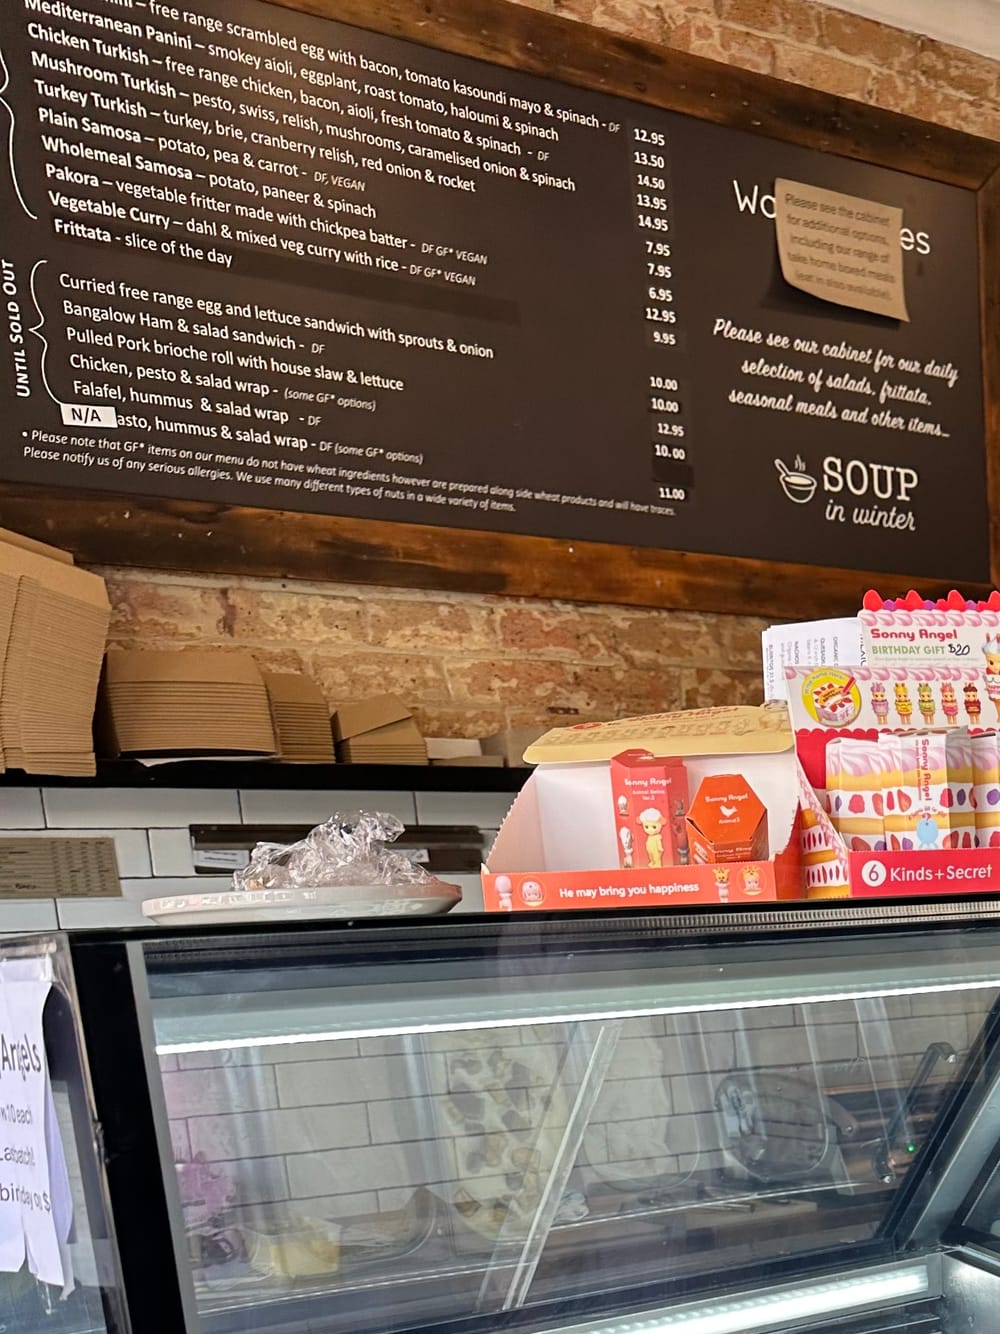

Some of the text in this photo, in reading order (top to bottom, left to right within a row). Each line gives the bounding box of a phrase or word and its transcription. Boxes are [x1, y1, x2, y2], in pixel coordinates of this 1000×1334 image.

[24, 0, 559, 141] Mediterranean Panini smokey aioli, eggplant, roast tomato, haloumi & spinach
[31, 50, 575, 191] Mushroom Turkish pesto, swiss, relish, mushrooms, caramelised onion & spinach
[633, 128, 665, 146] 12.95
[633, 151, 664, 168] 13.50
[41, 134, 376, 218] Wholemeal Samosa potato, paneer & spinach
[637, 173, 665, 190] 14.50
[636, 193, 667, 210] 13.95
[637, 214, 668, 231] 14.95
[54, 218, 232, 268] Frittata slice of the day
[645, 240, 670, 256] 7.95
[647, 262, 671, 278] 7.95
[648, 286, 672, 302] 6.95
[59, 273, 493, 358] Curried free range egg and lettuce sandwich with sprouts & onion
[645, 307, 676, 323] 12.95
[1, 259, 31, 398] UNTIL SOLD OUT
[653, 330, 676, 345] 9.95
[713, 318, 959, 388] Please see our cabinet for our daily
[649, 376, 677, 390] 10.00
[742, 358, 804, 383] selection
[808, 370, 823, 393] of
[651, 397, 678, 412] 10.00
[729, 389, 793, 412] seasonal
[796, 401, 837, 420] meals
[841, 406, 868, 425] and
[871, 411, 905, 430] other
[71, 408, 102, 423] N/A
[657, 422, 684, 437] 12.95
[23, 446, 233, 480] Please notify us of any serious allergies.
[823, 457, 919, 501] SOUP
[658, 487, 685, 500] 11.00
[825, 500, 916, 531] in winter
[870, 629, 958, 642] Sonny Angel
[872, 645, 946, 655] BIRTHDAY GIFT
[948, 644, 971, 656] $20
[921, 739, 932, 801] Sonny Angel
[868, 864, 879, 882] 6
[559, 883, 699, 900] He may bring you happiness
